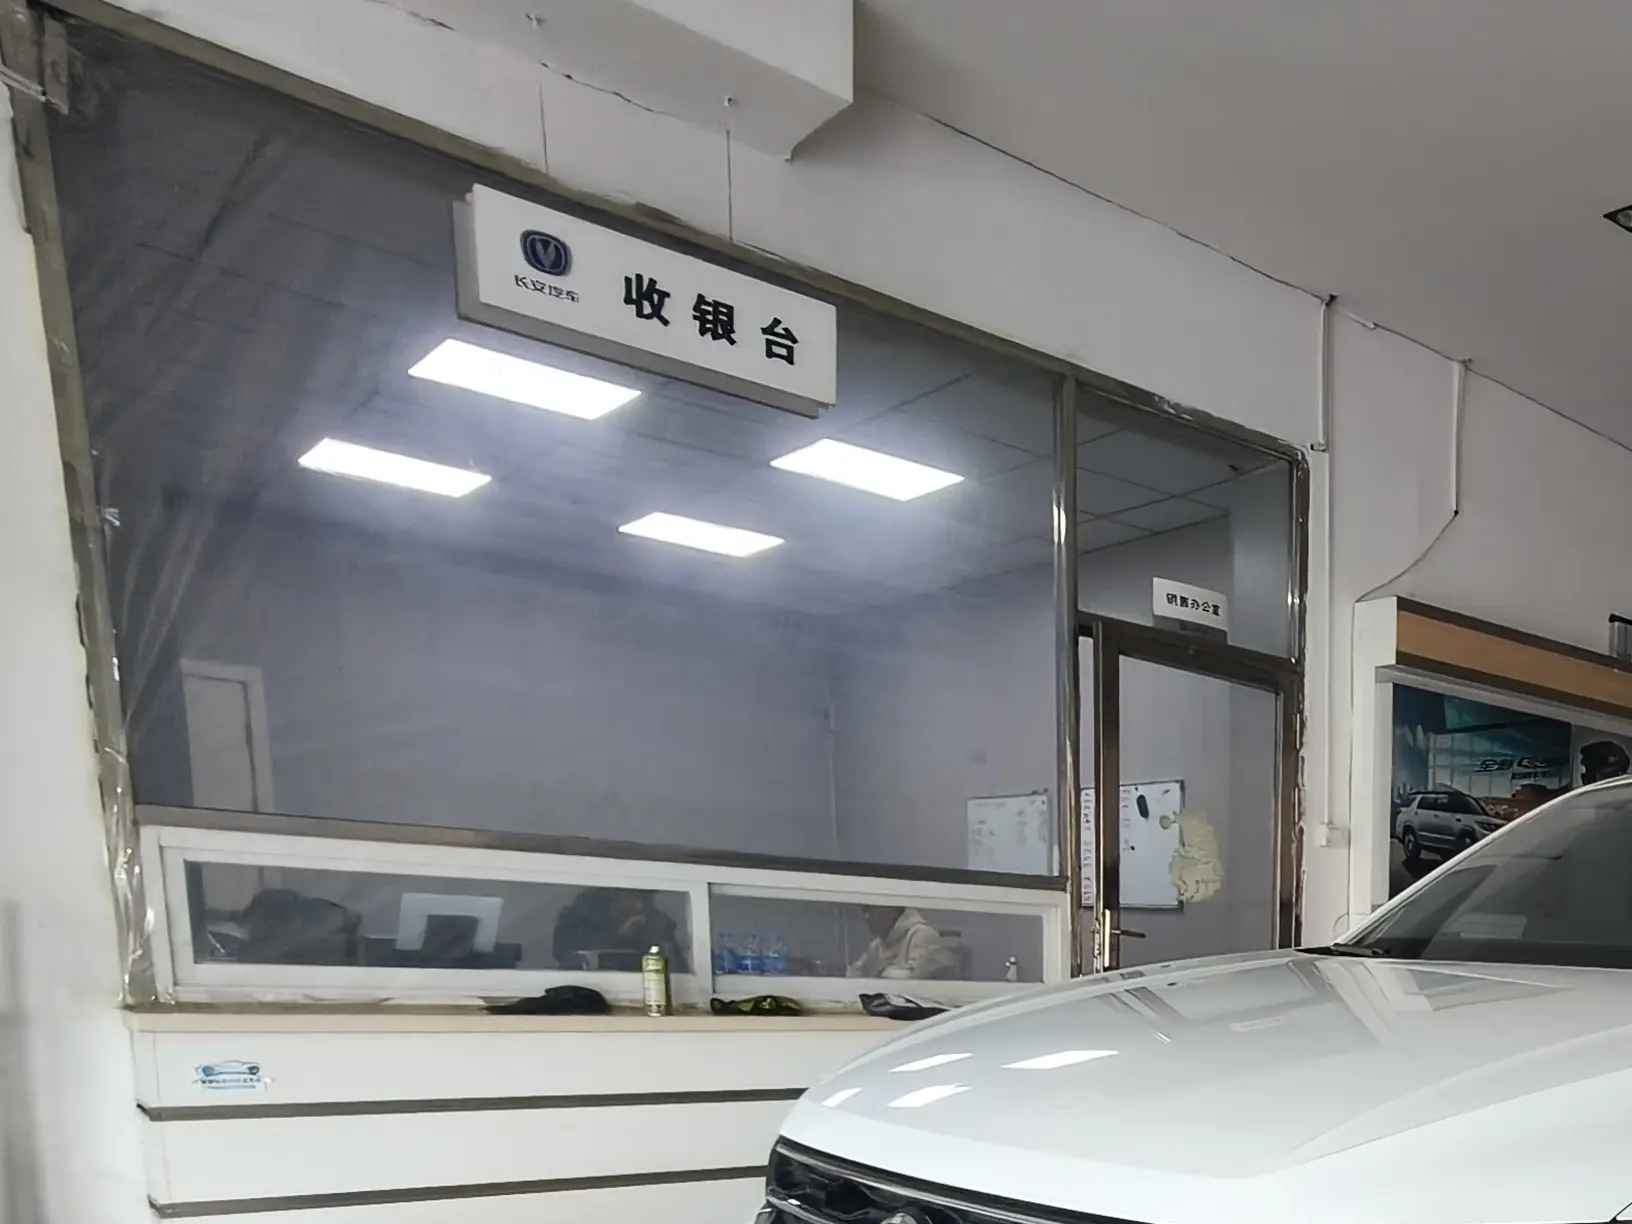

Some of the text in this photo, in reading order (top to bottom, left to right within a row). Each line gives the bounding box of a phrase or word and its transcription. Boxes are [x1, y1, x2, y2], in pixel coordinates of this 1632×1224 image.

[513, 274, 580, 303] 长安汽车
[623, 273, 799, 366] 收银台
